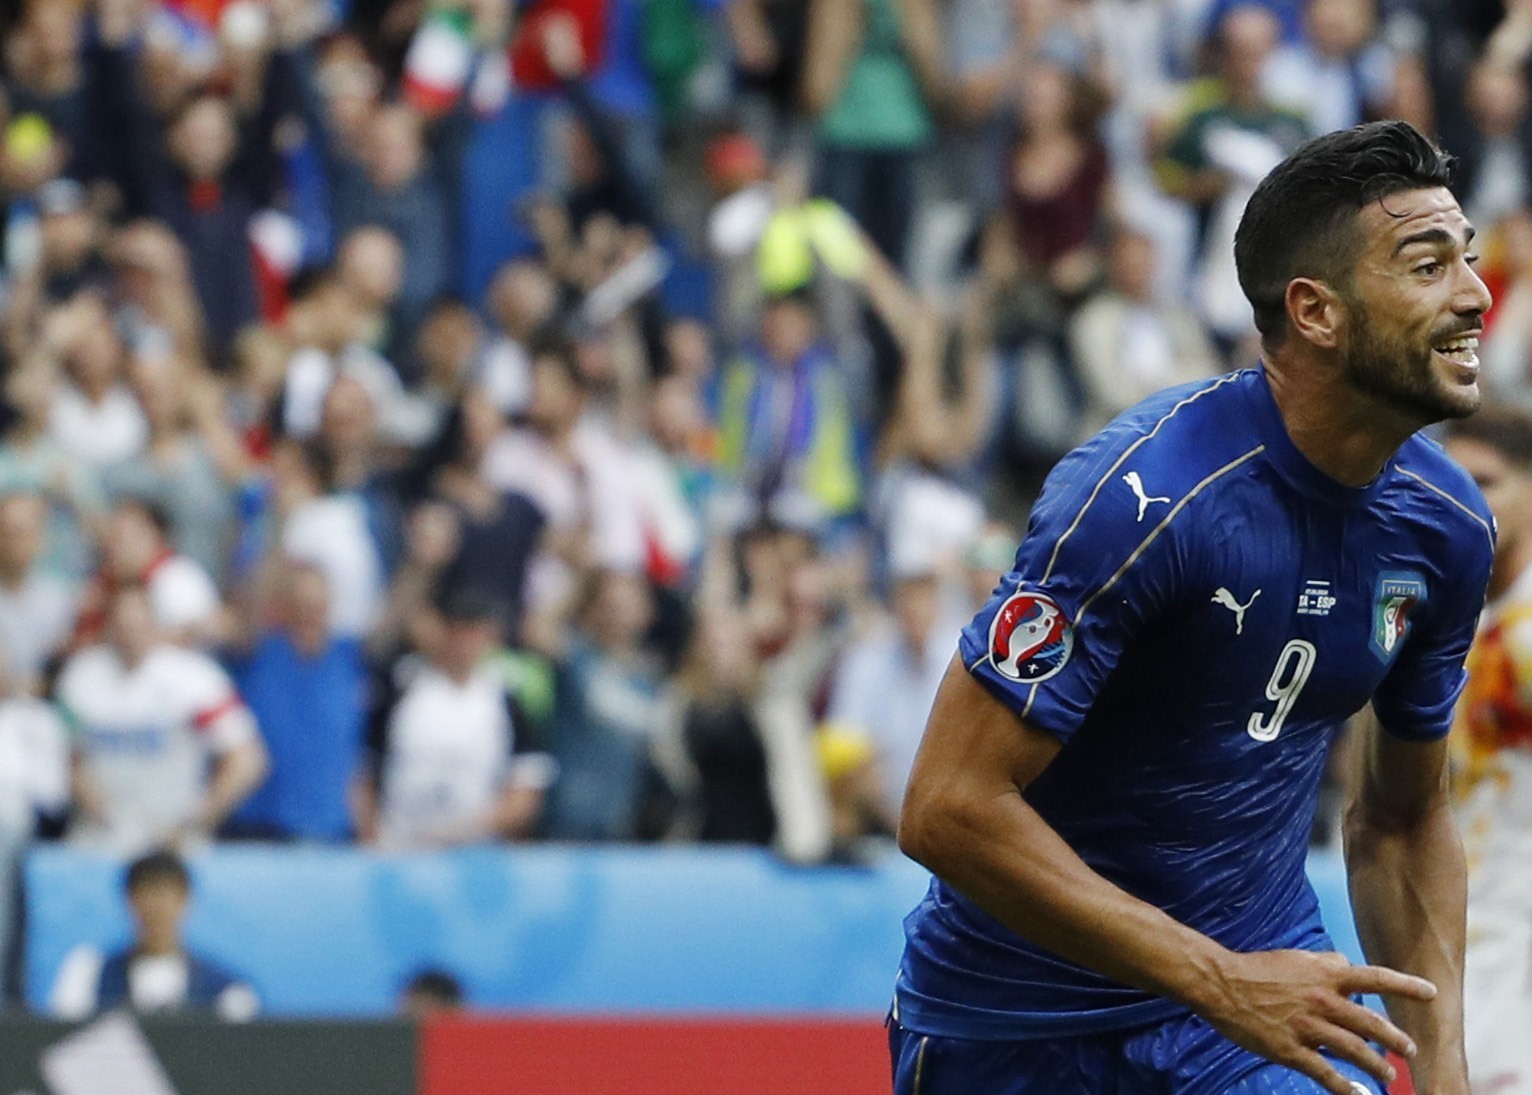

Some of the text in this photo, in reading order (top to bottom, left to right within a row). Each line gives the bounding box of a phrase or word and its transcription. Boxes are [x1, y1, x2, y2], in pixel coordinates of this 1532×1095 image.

[1387, 585, 1416, 596] ITALIA
[1316, 596, 1337, 609] ESP
[1247, 639, 1317, 742] 9
